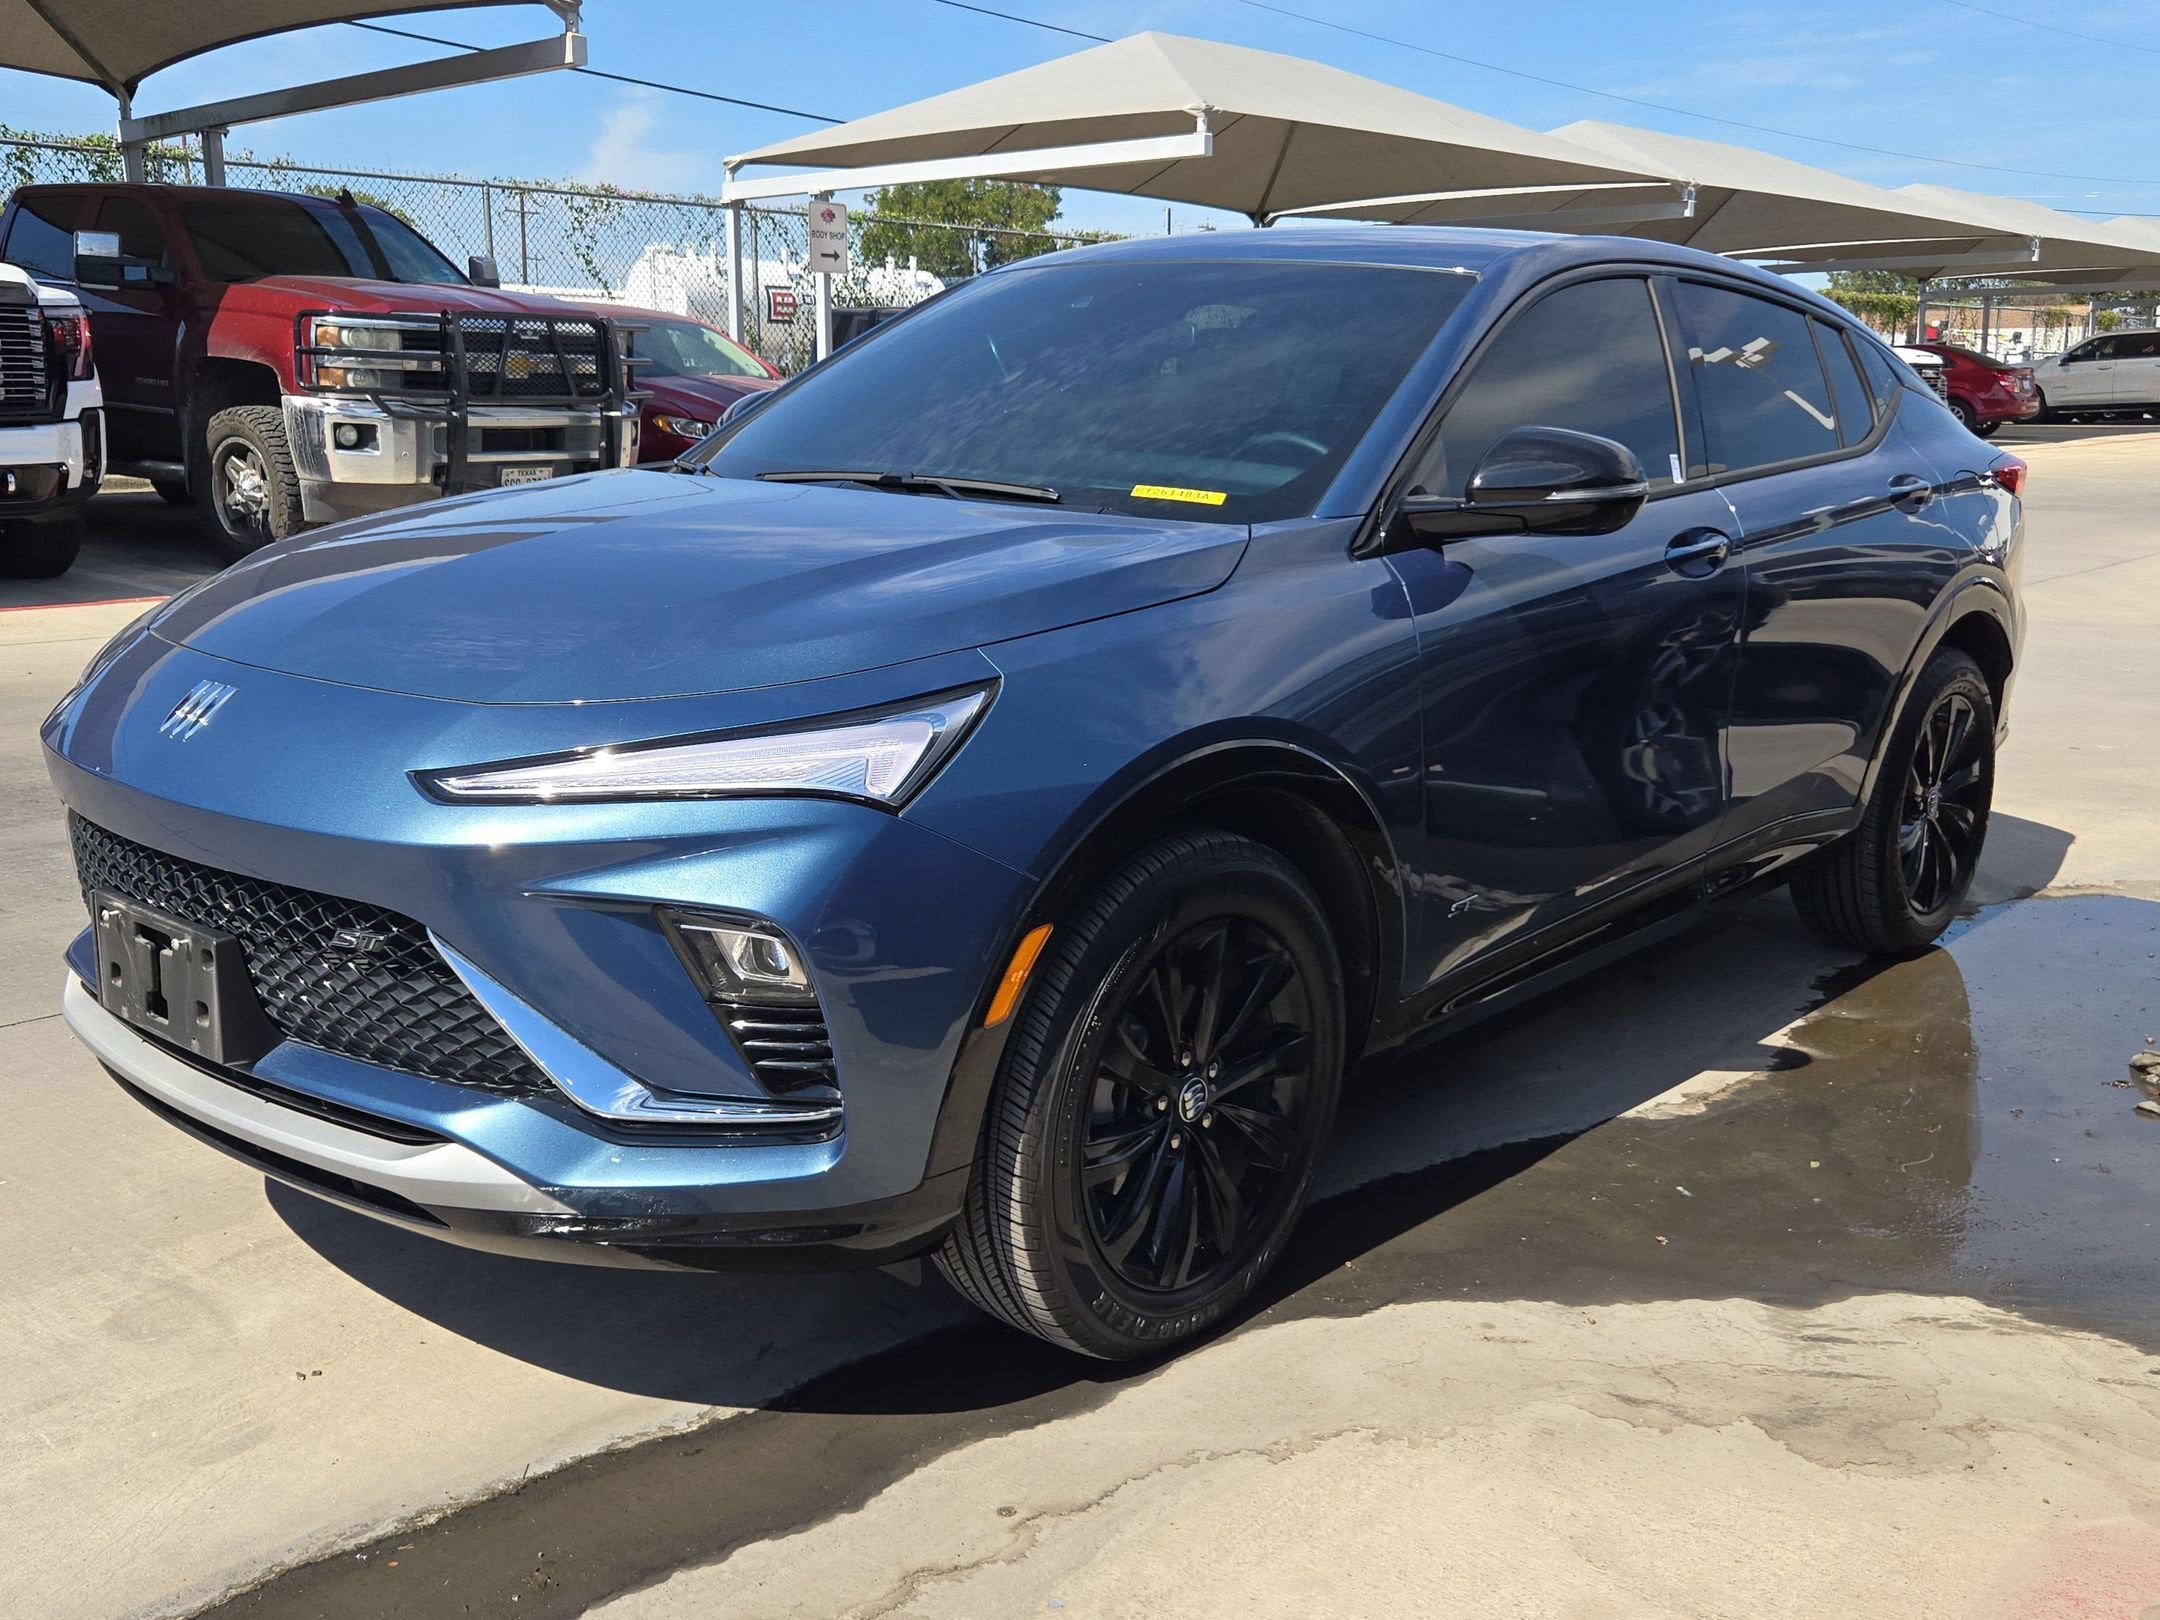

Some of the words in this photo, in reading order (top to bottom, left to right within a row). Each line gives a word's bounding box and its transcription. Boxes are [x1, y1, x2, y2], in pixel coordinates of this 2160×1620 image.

[811, 230, 828, 239] BODY
[829, 232, 845, 240] SHOP
[331, 928, 387, 952] ST
